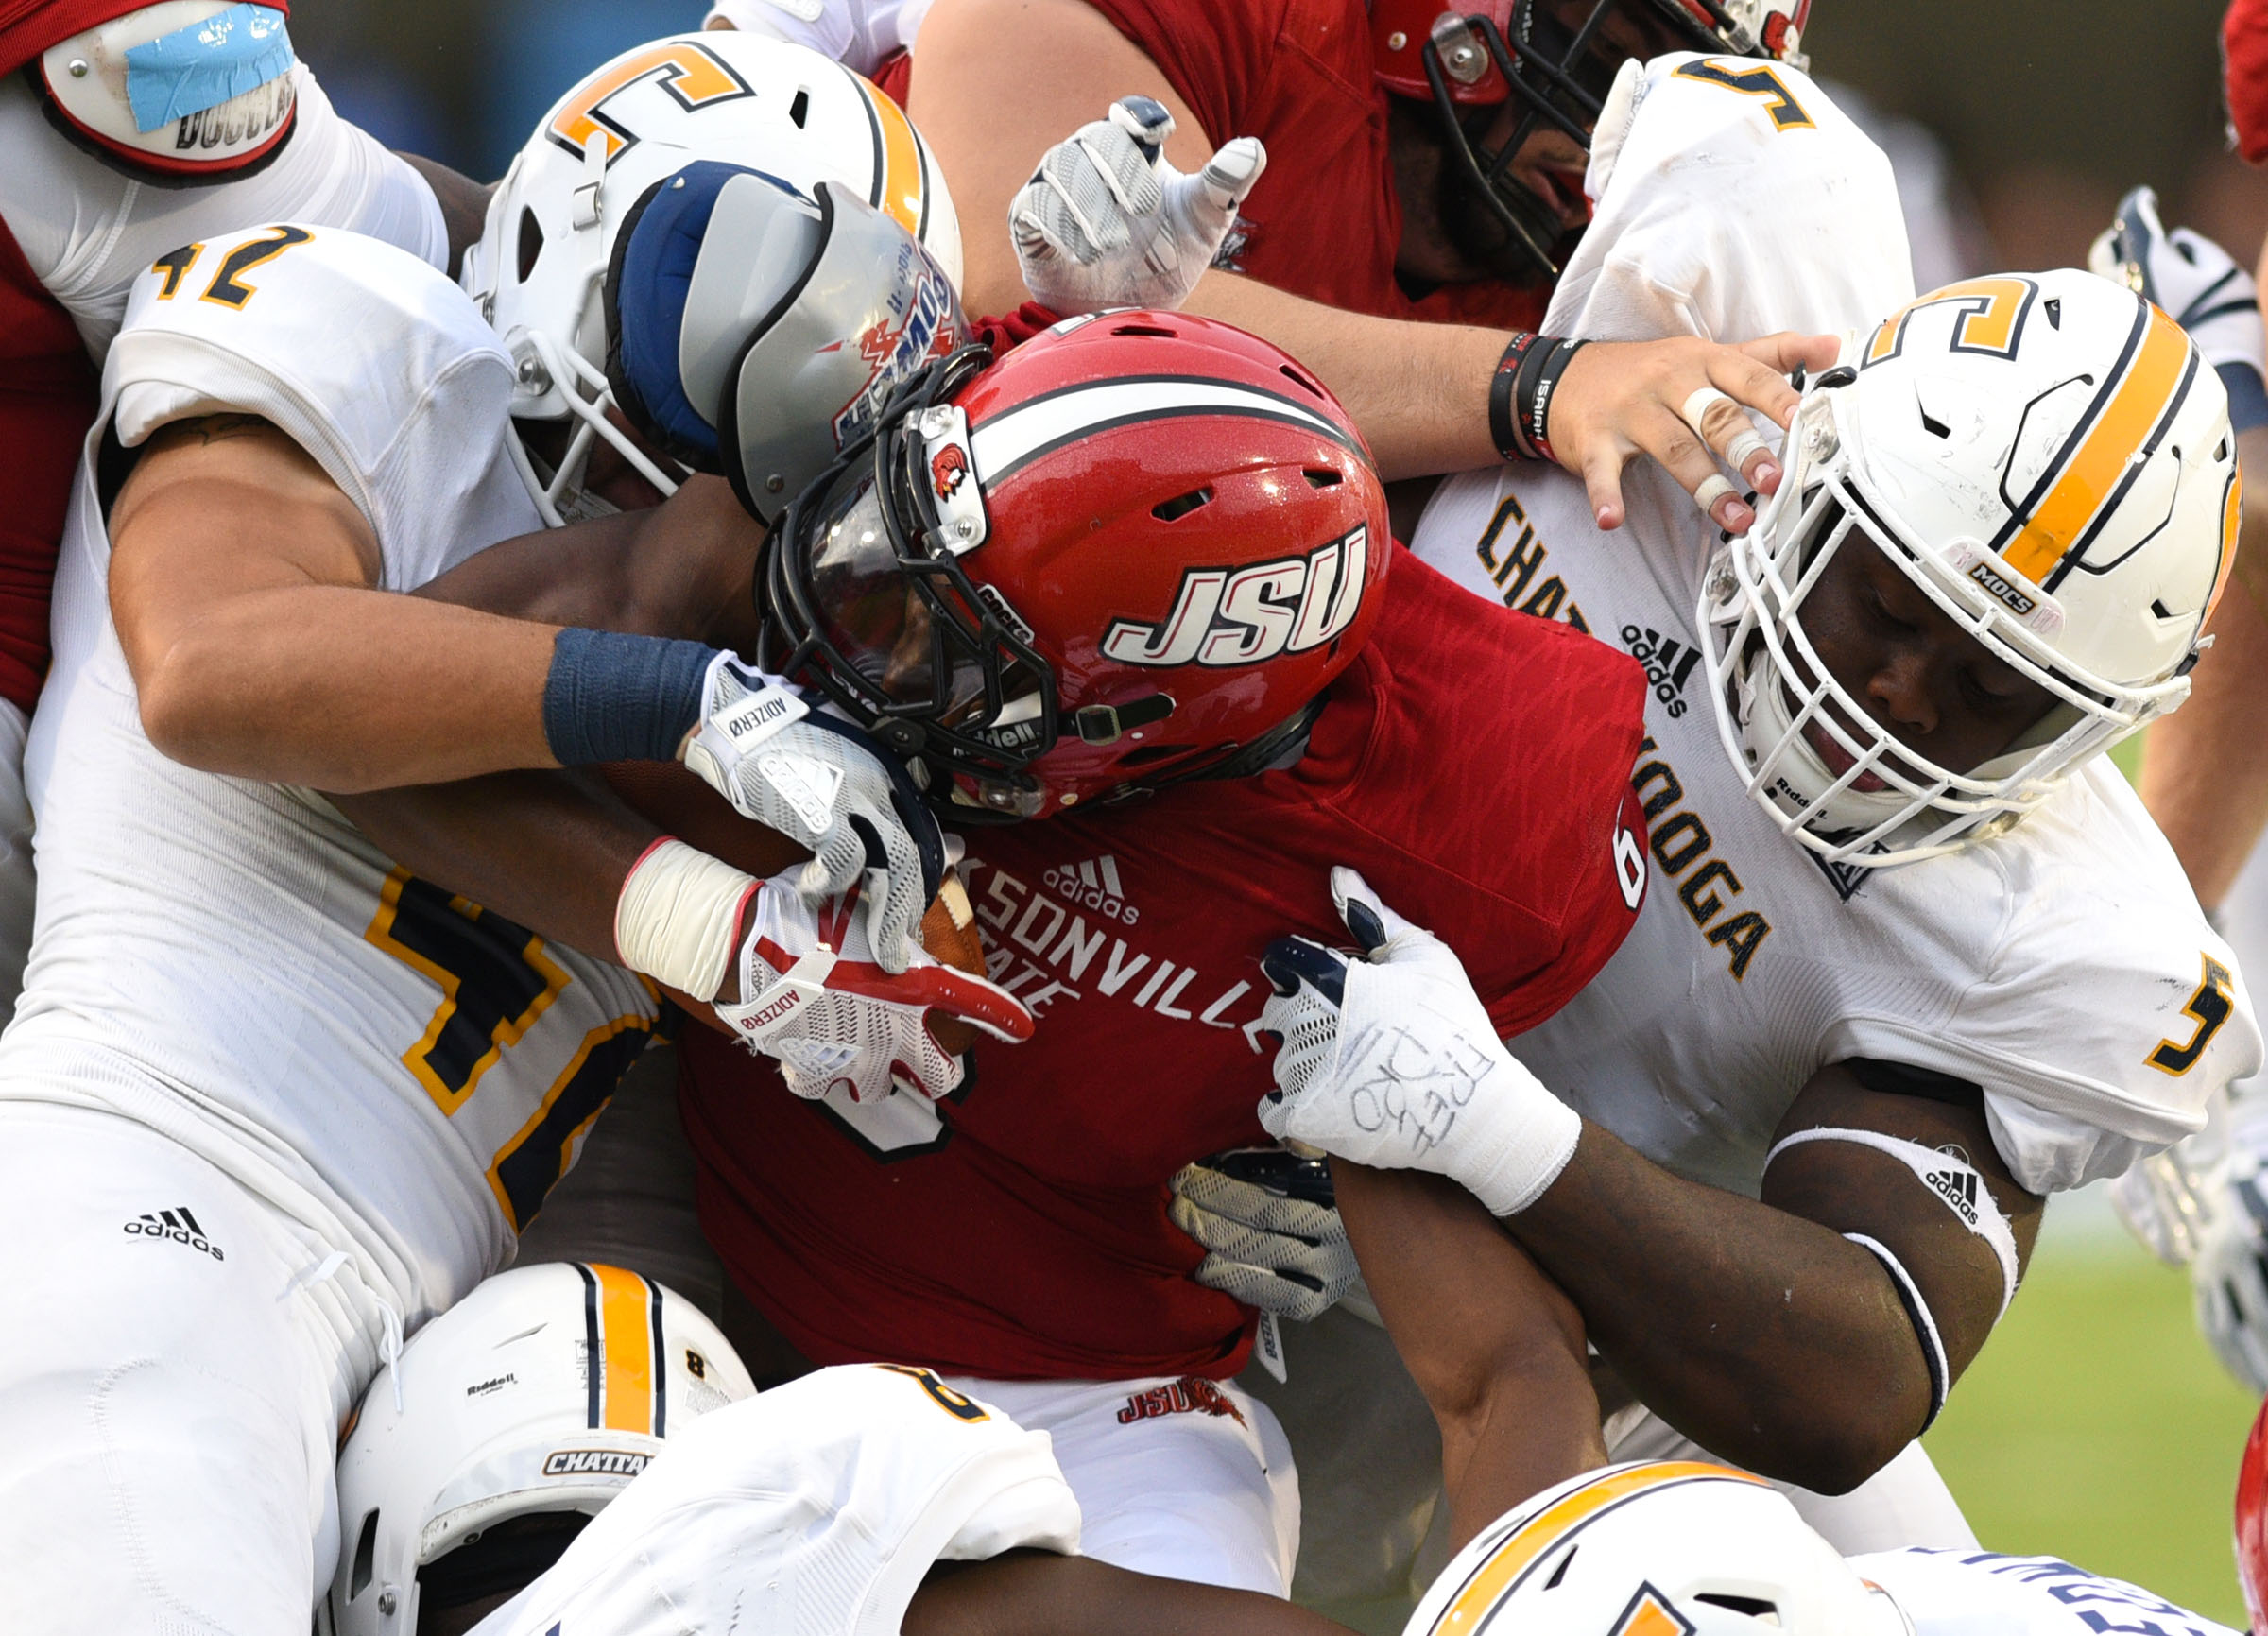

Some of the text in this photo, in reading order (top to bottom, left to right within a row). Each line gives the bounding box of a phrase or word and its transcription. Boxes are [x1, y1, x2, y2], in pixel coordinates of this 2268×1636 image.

[1098, 520, 1367, 669] JSU
[1969, 563, 2035, 614] MOCS
[1621, 624, 1688, 720] adidas
[1043, 867, 1141, 926] adidas
[2142, 950, 2235, 1077] 5
[1926, 1172, 1978, 1225] adidas
[124, 1222, 225, 1262] adidas
[685, 1348, 706, 1382] 8
[1117, 1376, 1193, 1424] JSU
[545, 1452, 650, 1476] CHATTA
